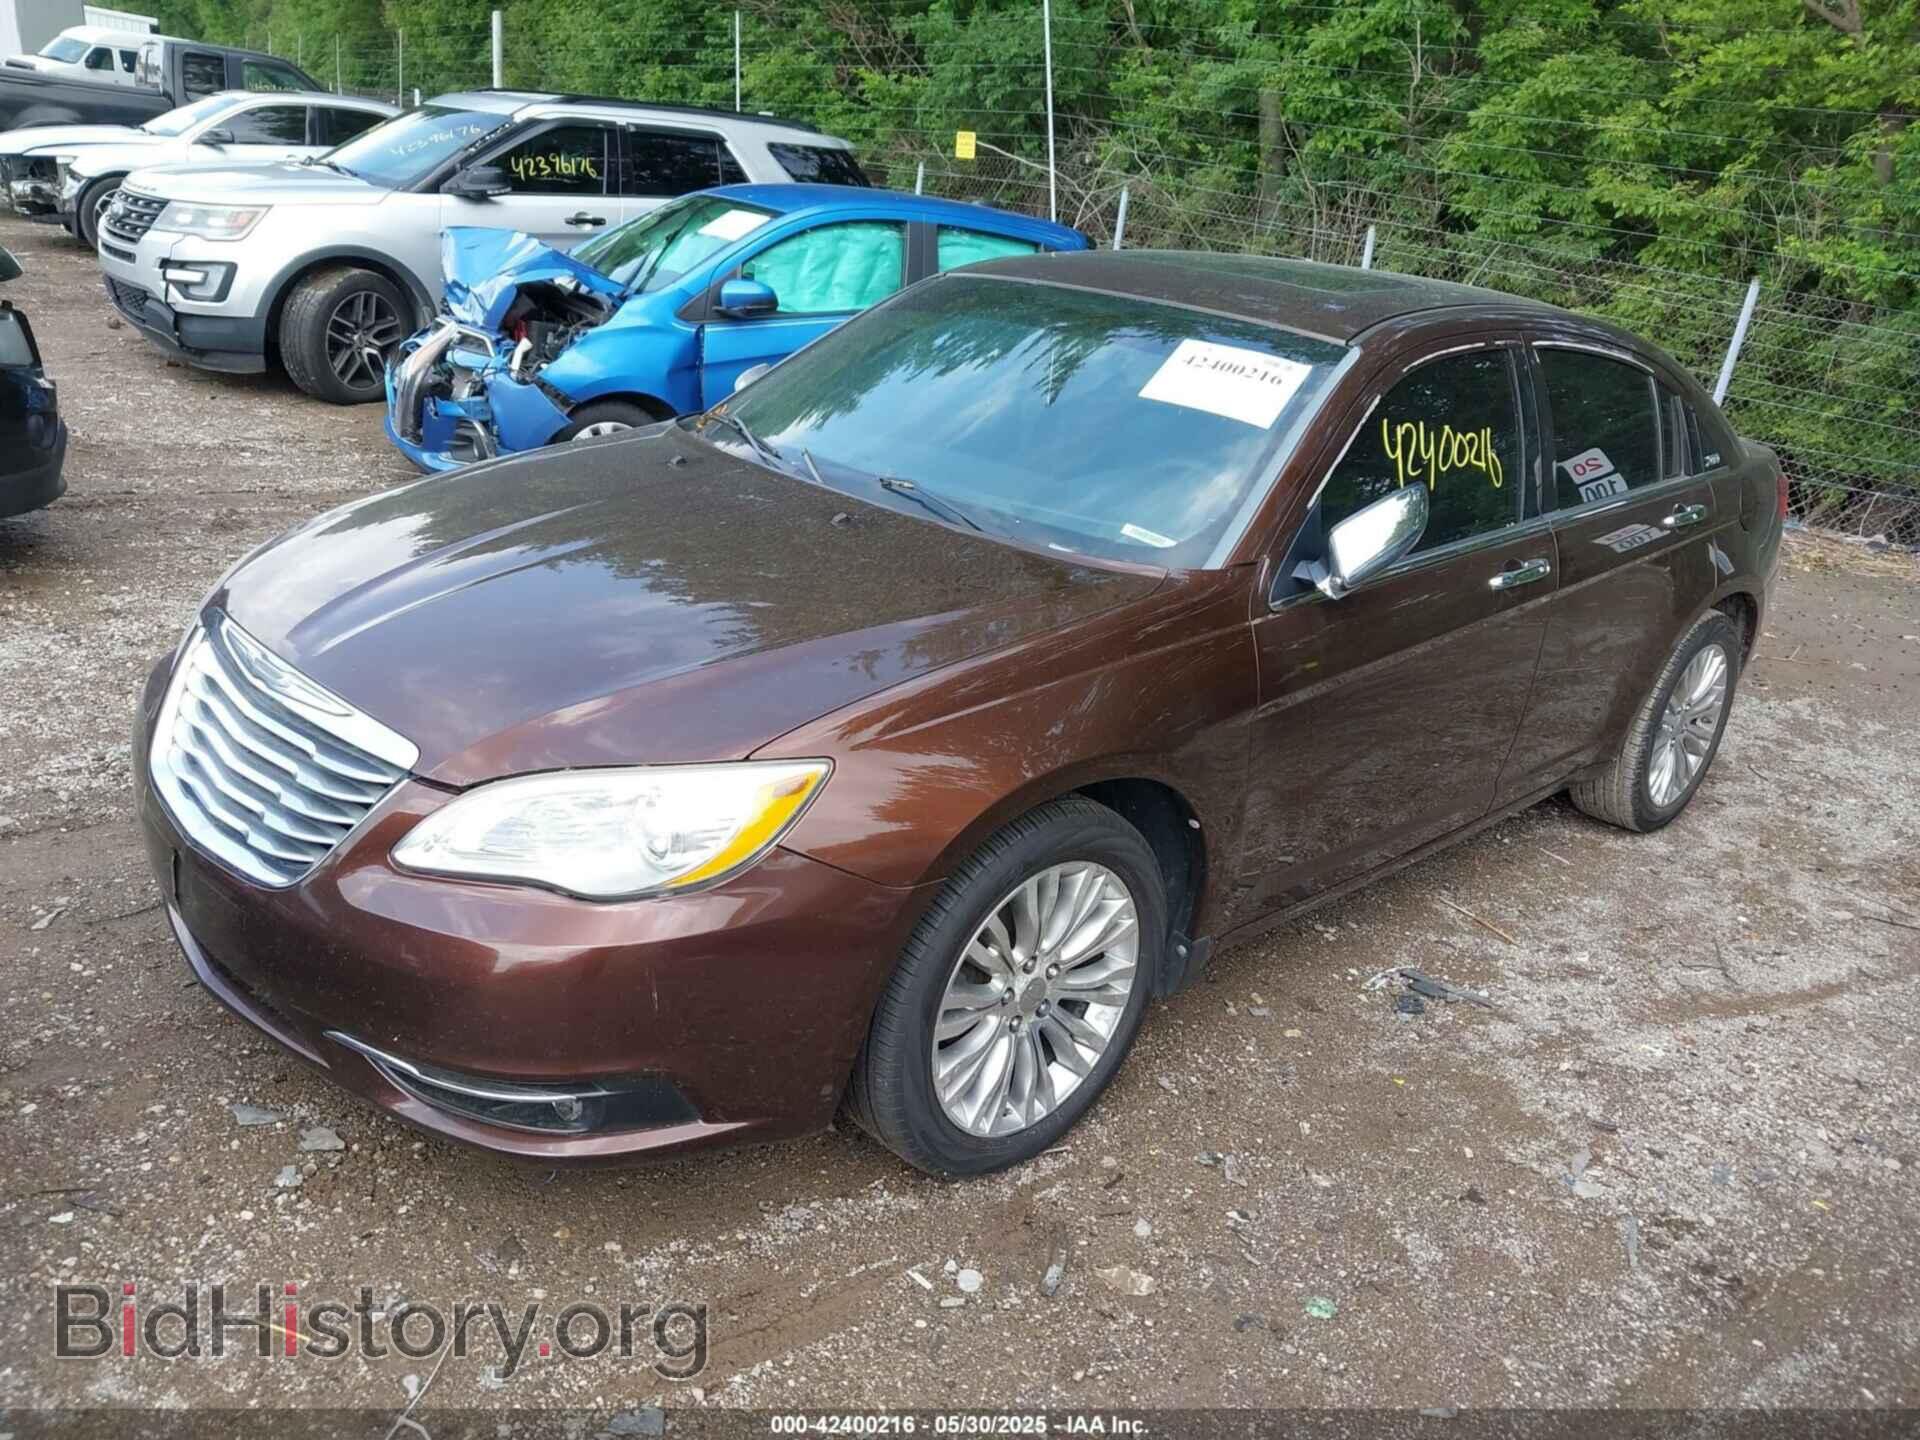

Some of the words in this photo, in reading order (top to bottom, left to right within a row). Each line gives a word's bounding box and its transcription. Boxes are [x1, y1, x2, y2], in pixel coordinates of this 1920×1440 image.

[511, 152, 597, 181] 42396176
[1184, 354, 1283, 386] 42400216
[1383, 418, 1502, 491] 42400216
